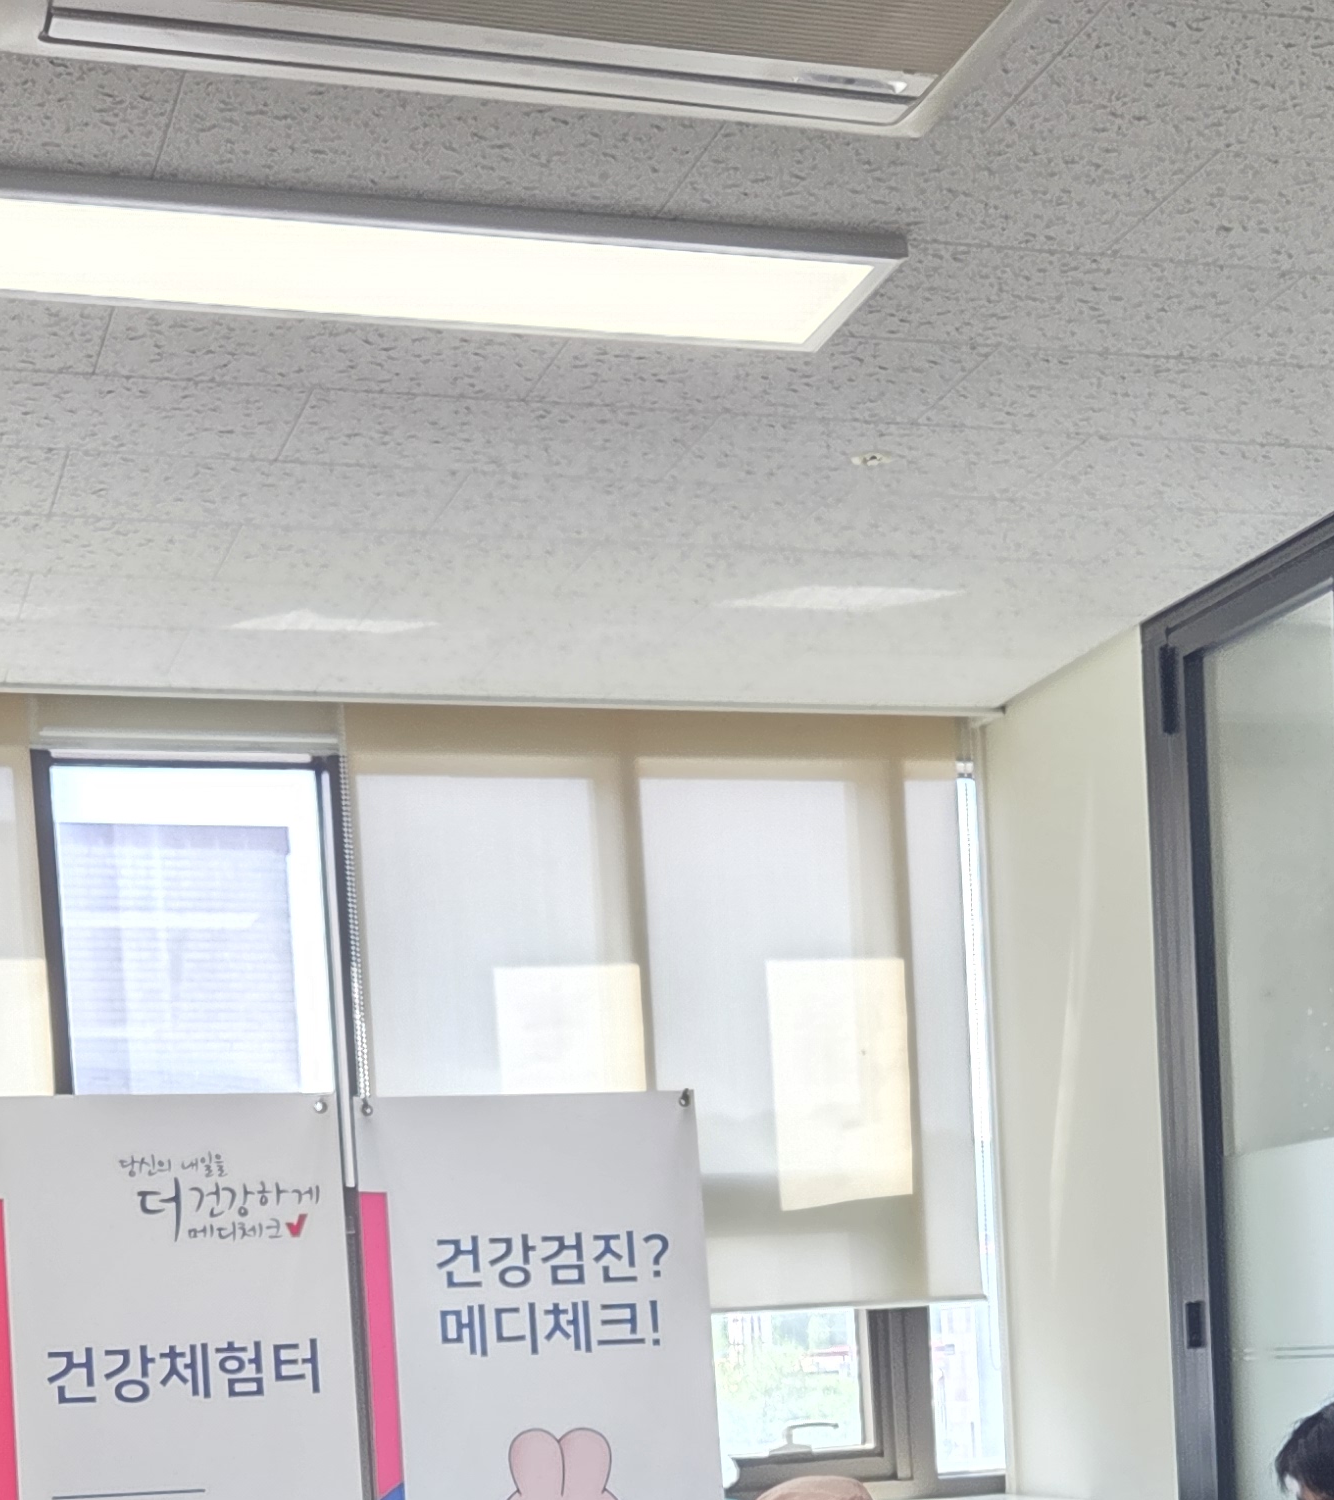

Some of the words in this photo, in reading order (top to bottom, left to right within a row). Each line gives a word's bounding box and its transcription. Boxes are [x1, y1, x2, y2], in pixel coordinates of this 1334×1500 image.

[119, 1153, 172, 1177] 당신의
[181, 1151, 229, 1178] 내일을
[137, 1177, 182, 1243] 더
[188, 1180, 321, 1218] 건강하게
[187, 1217, 284, 1242] 메디체크
[436, 1231, 670, 1289] 건강검진?
[439, 1299, 662, 1358] 메디체크!
[46, 1338, 321, 1405] 건강체험터
